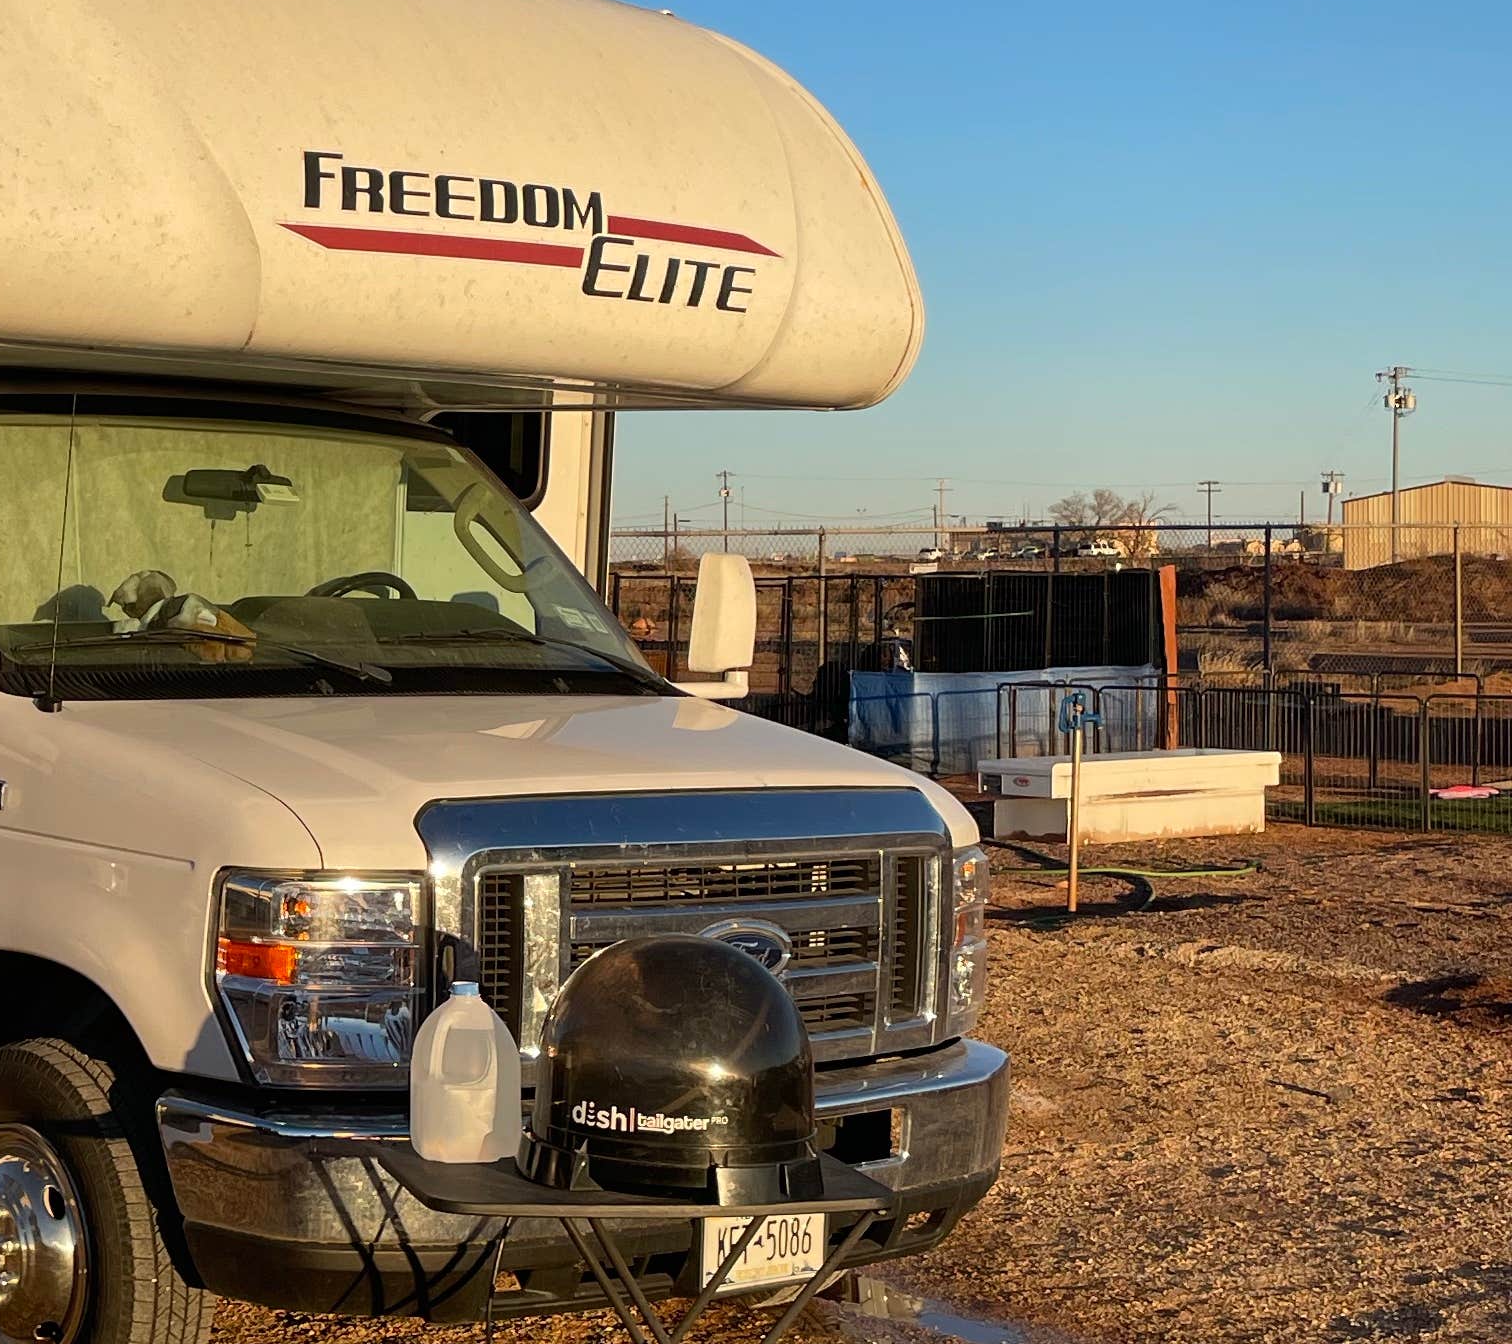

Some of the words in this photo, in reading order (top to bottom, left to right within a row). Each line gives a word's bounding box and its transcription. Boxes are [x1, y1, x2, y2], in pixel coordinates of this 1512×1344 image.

[302, 150, 602, 235] FREEDOM
[581, 235, 757, 314] ELITE
[572, 1100, 628, 1132] dish
[637, 1113, 710, 1135] tailgater
[710, 1116, 729, 1125] PRO
